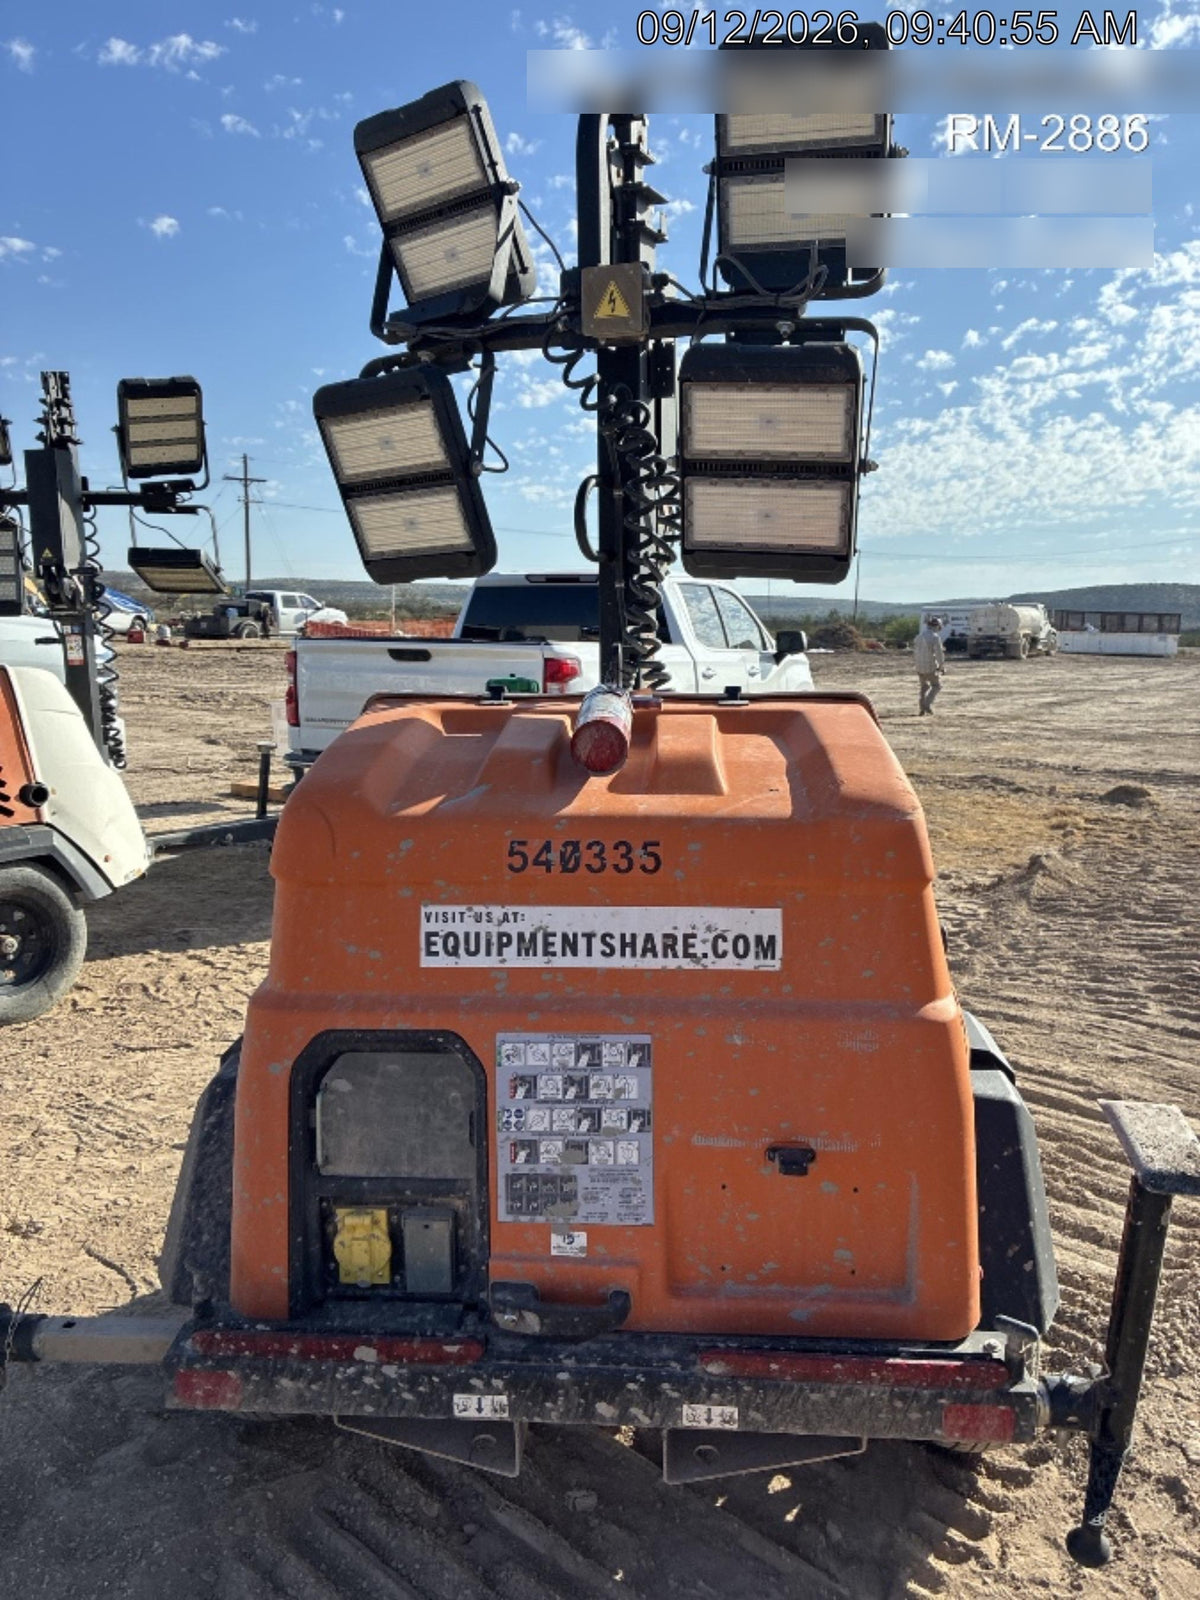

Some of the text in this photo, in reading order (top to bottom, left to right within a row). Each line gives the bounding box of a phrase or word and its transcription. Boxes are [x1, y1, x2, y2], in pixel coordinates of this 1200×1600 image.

[508, 840, 662, 875] 540335
[424, 911, 526, 924] VISIT US AT:
[424, 931, 777, 959] EQUIPMENTSHARE.COM
